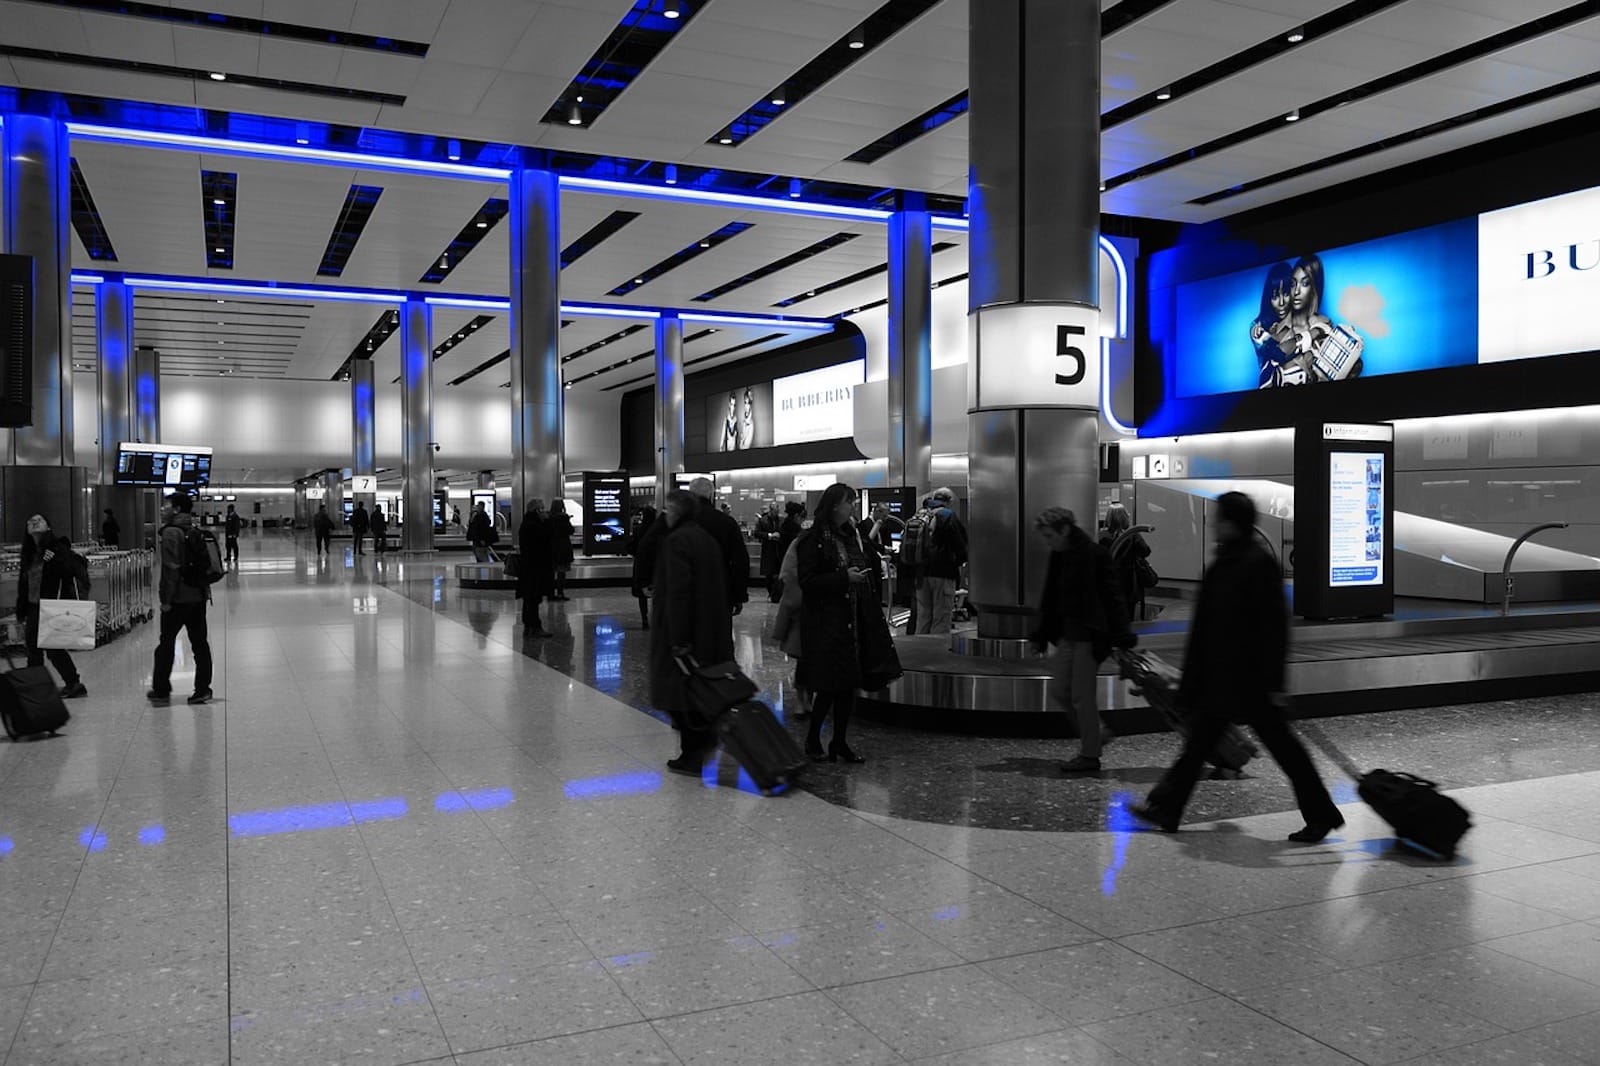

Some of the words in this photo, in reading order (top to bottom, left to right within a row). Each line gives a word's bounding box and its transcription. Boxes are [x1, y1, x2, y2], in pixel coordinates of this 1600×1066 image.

[1520, 239, 1600, 281] BU
[1055, 324, 1086, 386] 5
[781, 386, 851, 412] BURBERRY
[312, 489, 318, 497] 9
[362, 479, 369, 489] 7
